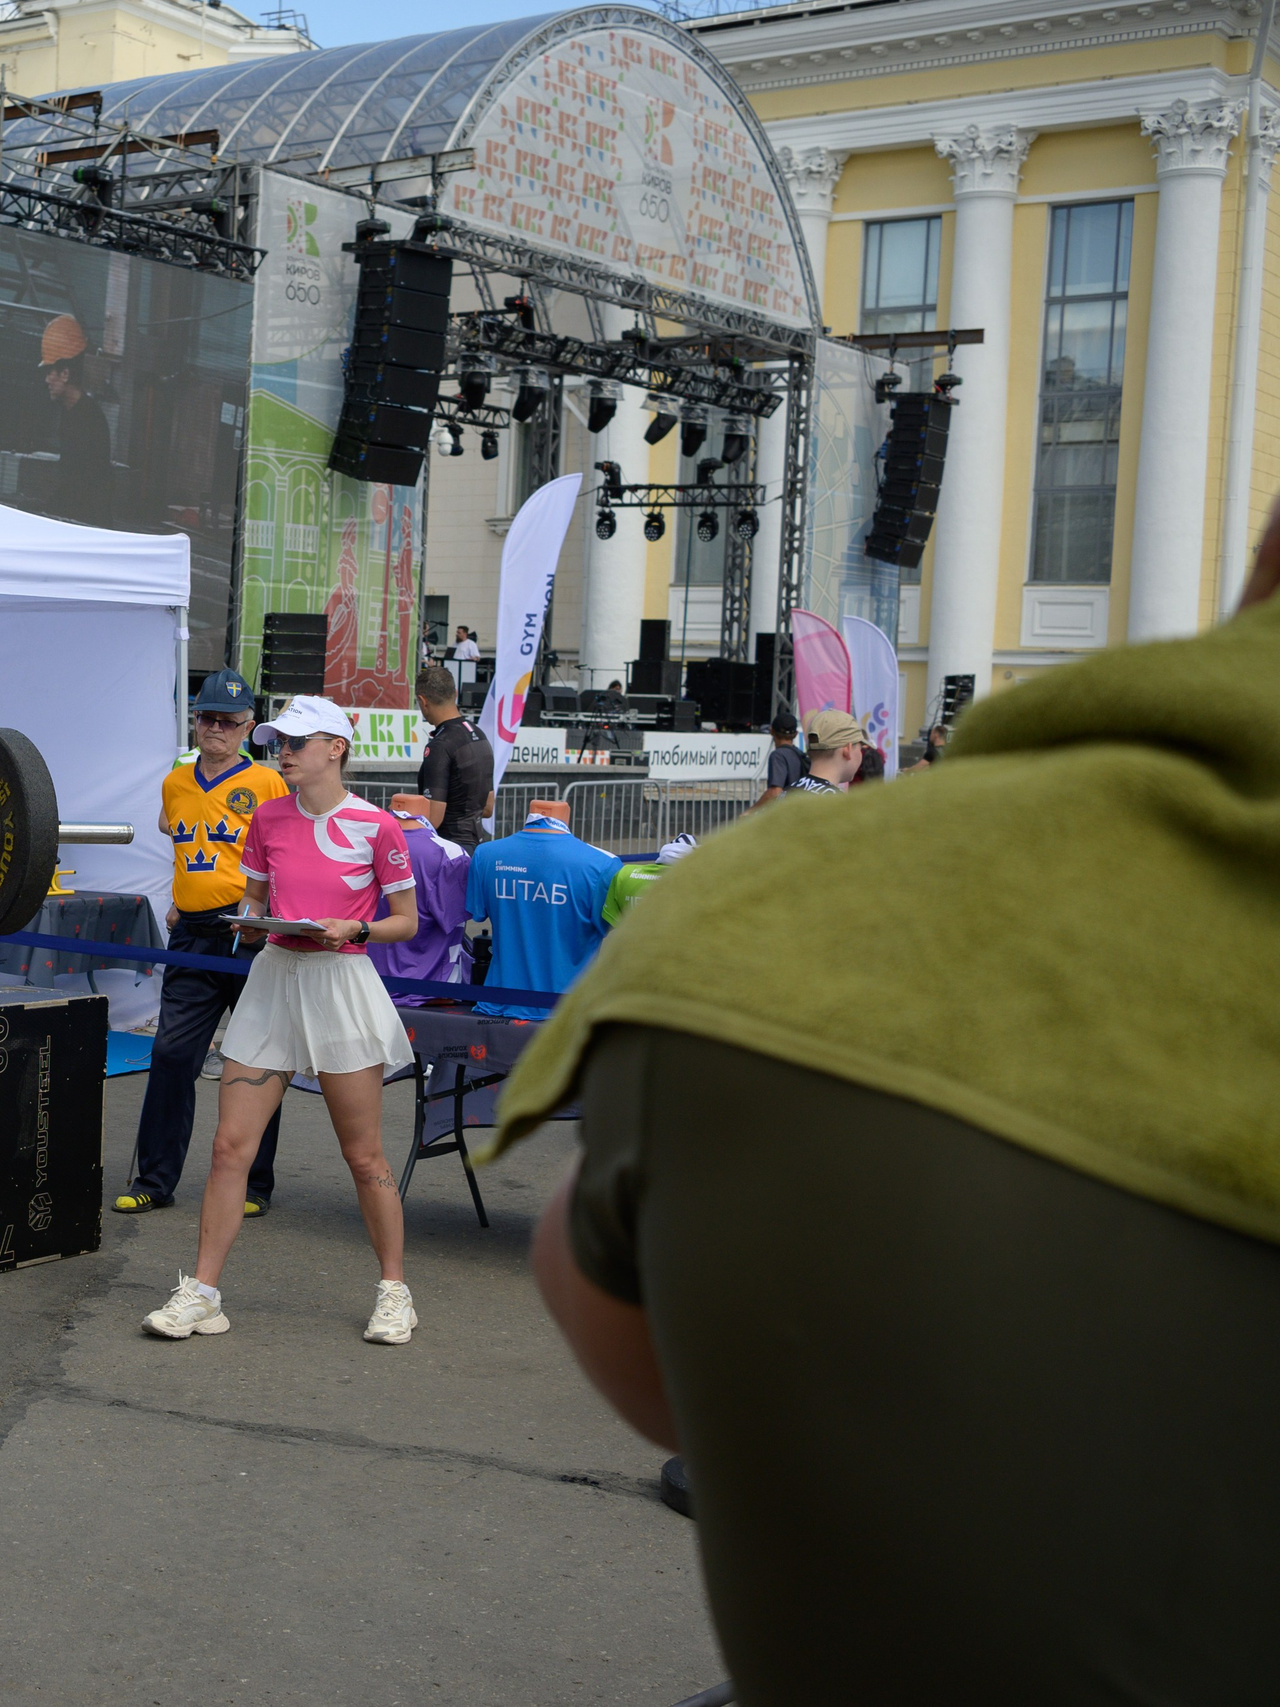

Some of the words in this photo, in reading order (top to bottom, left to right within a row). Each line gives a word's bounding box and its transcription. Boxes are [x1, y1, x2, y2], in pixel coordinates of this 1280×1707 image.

[639, 192, 670, 223] 650
[285, 263, 320, 281] КИРОВ
[285, 280, 321, 305] 650
[520, 613, 538, 656] GYM
[508, 746, 558, 764] дения
[650, 745, 717, 766] любимый
[721, 747, 760, 771] город!
[495, 878, 568, 906] ШТАБ
[438, 1052, 468, 1060] Вятские
[36, 1035, 51, 1187] YOUSTEEL
